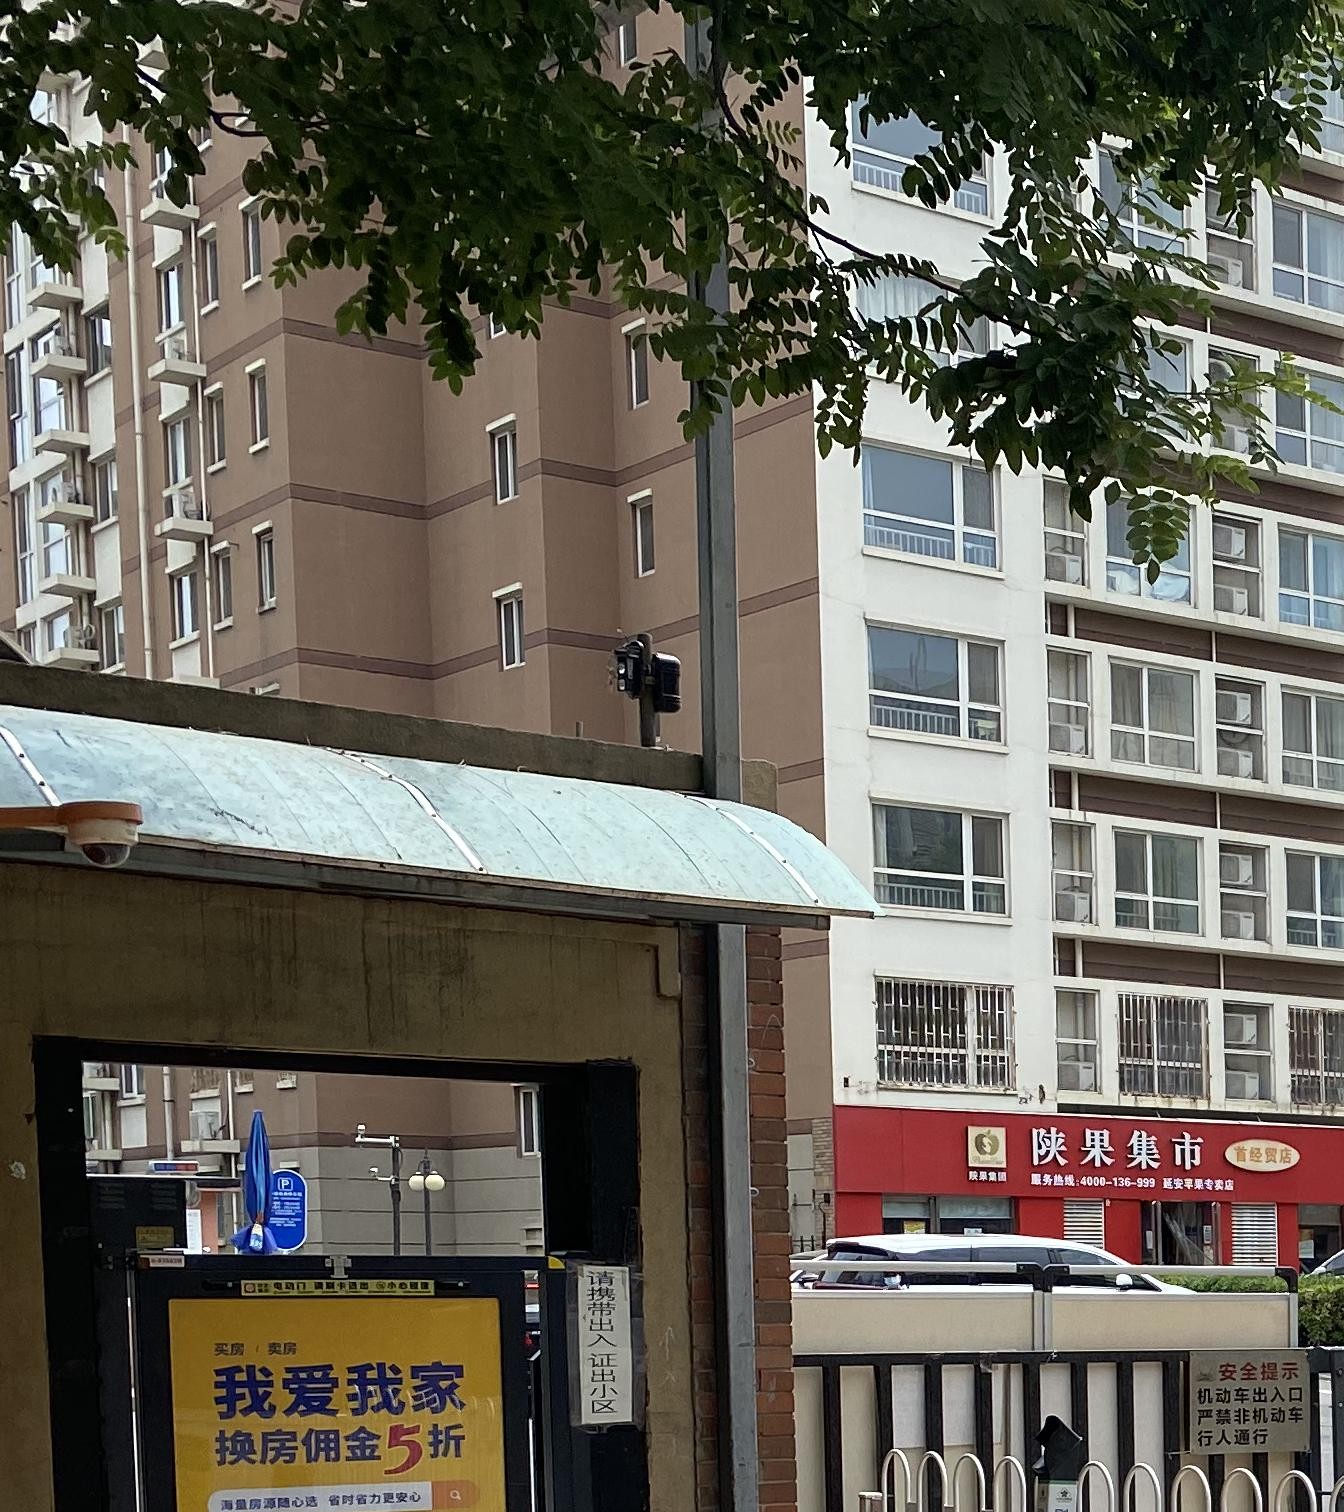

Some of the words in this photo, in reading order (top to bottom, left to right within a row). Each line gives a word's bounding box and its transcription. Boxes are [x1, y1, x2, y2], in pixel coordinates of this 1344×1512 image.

[1030, 1126, 1205, 1171] 陕果集市
[1233, 1146, 1293, 1165] 首经贸店
[1162, 1177, 1235, 1191] 延安苹果专卖店
[213, 1342, 245, 1356] 买房
[268, 1342, 297, 1356] 卖房
[587, 1269, 619, 1415] 请携带出入证出小区
[1218, 1361, 1300, 1382] 安全提示
[212, 1360, 467, 1421] 我爱我家
[1196, 1386, 1304, 1405] 机动车出入口
[1196, 1406, 1304, 1426] 严禁非机动车
[1196, 1427, 1269, 1447] 行人通行
[214, 1423, 466, 1477] 换房佣金5折
[219, 1493, 319, 1512] 海量房源随心选
[328, 1490, 423, 1509] 省时省力更安心
